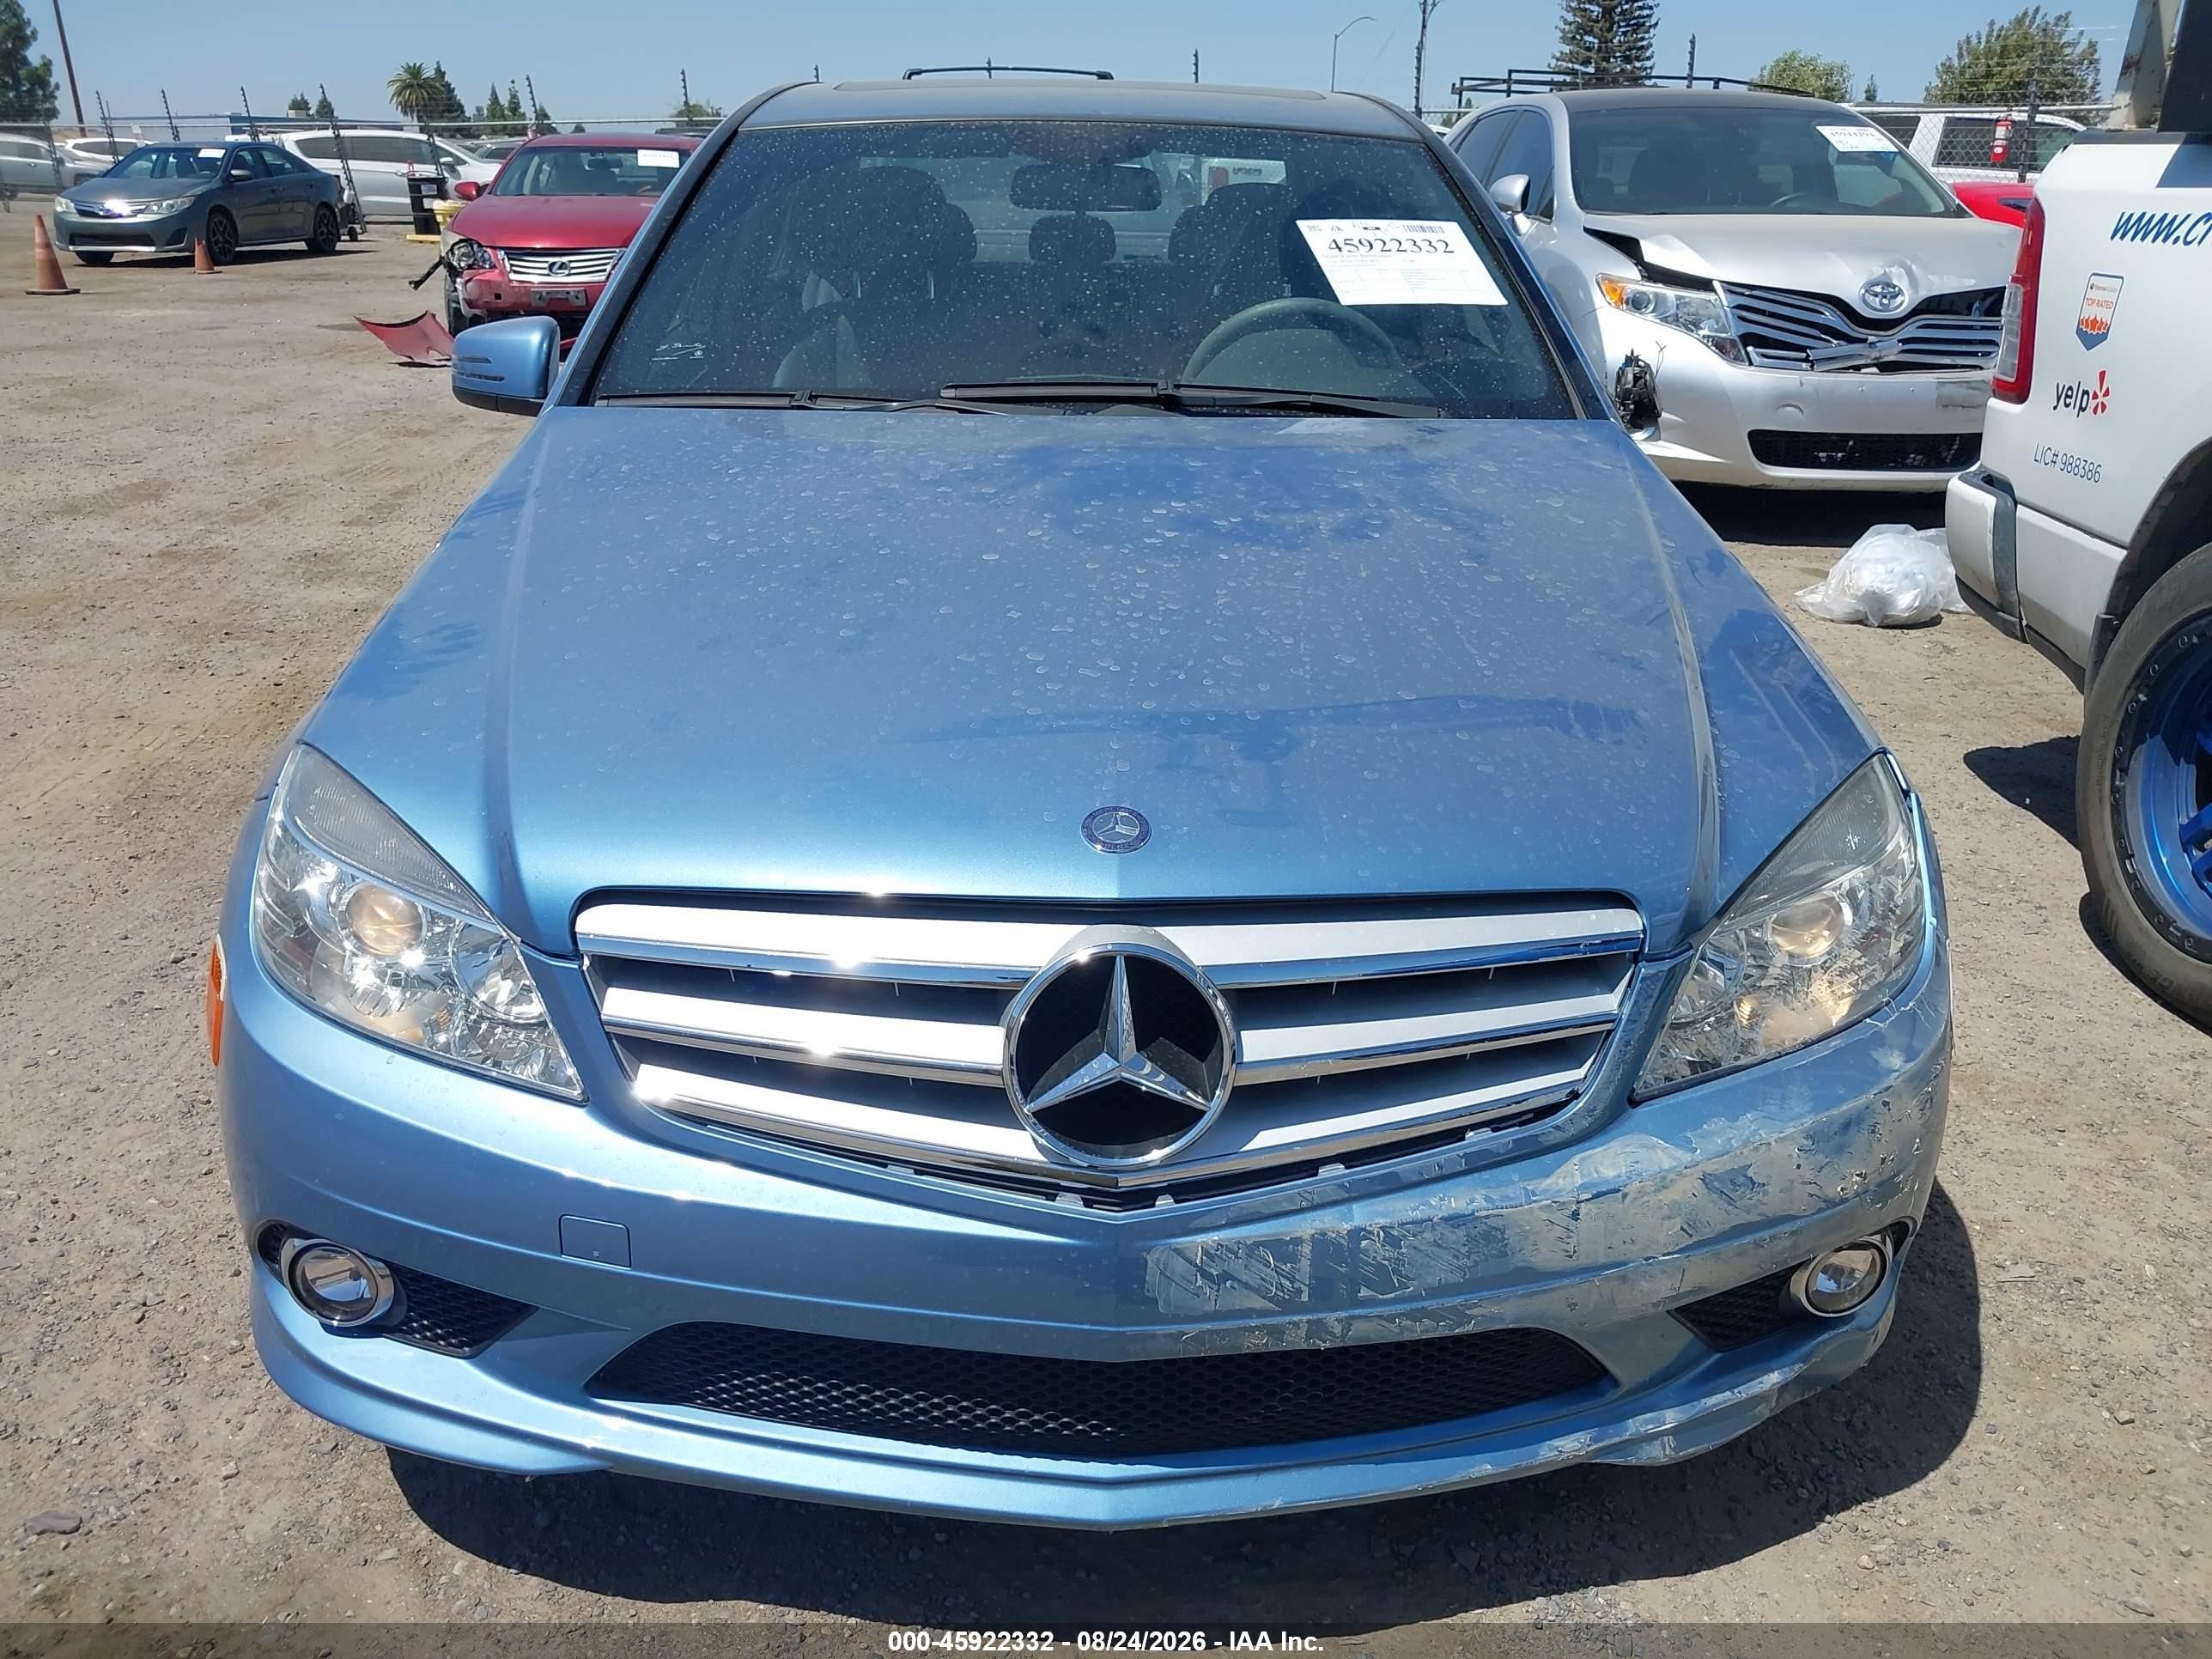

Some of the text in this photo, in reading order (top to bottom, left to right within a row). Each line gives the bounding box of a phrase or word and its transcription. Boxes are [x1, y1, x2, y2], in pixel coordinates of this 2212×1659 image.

[1328, 238, 1455, 253] 45922332
[2086, 297, 2114, 310] TOP RATED
[2053, 380, 2090, 418] yelp
[2033, 443, 2102, 483] LIC# 988386
